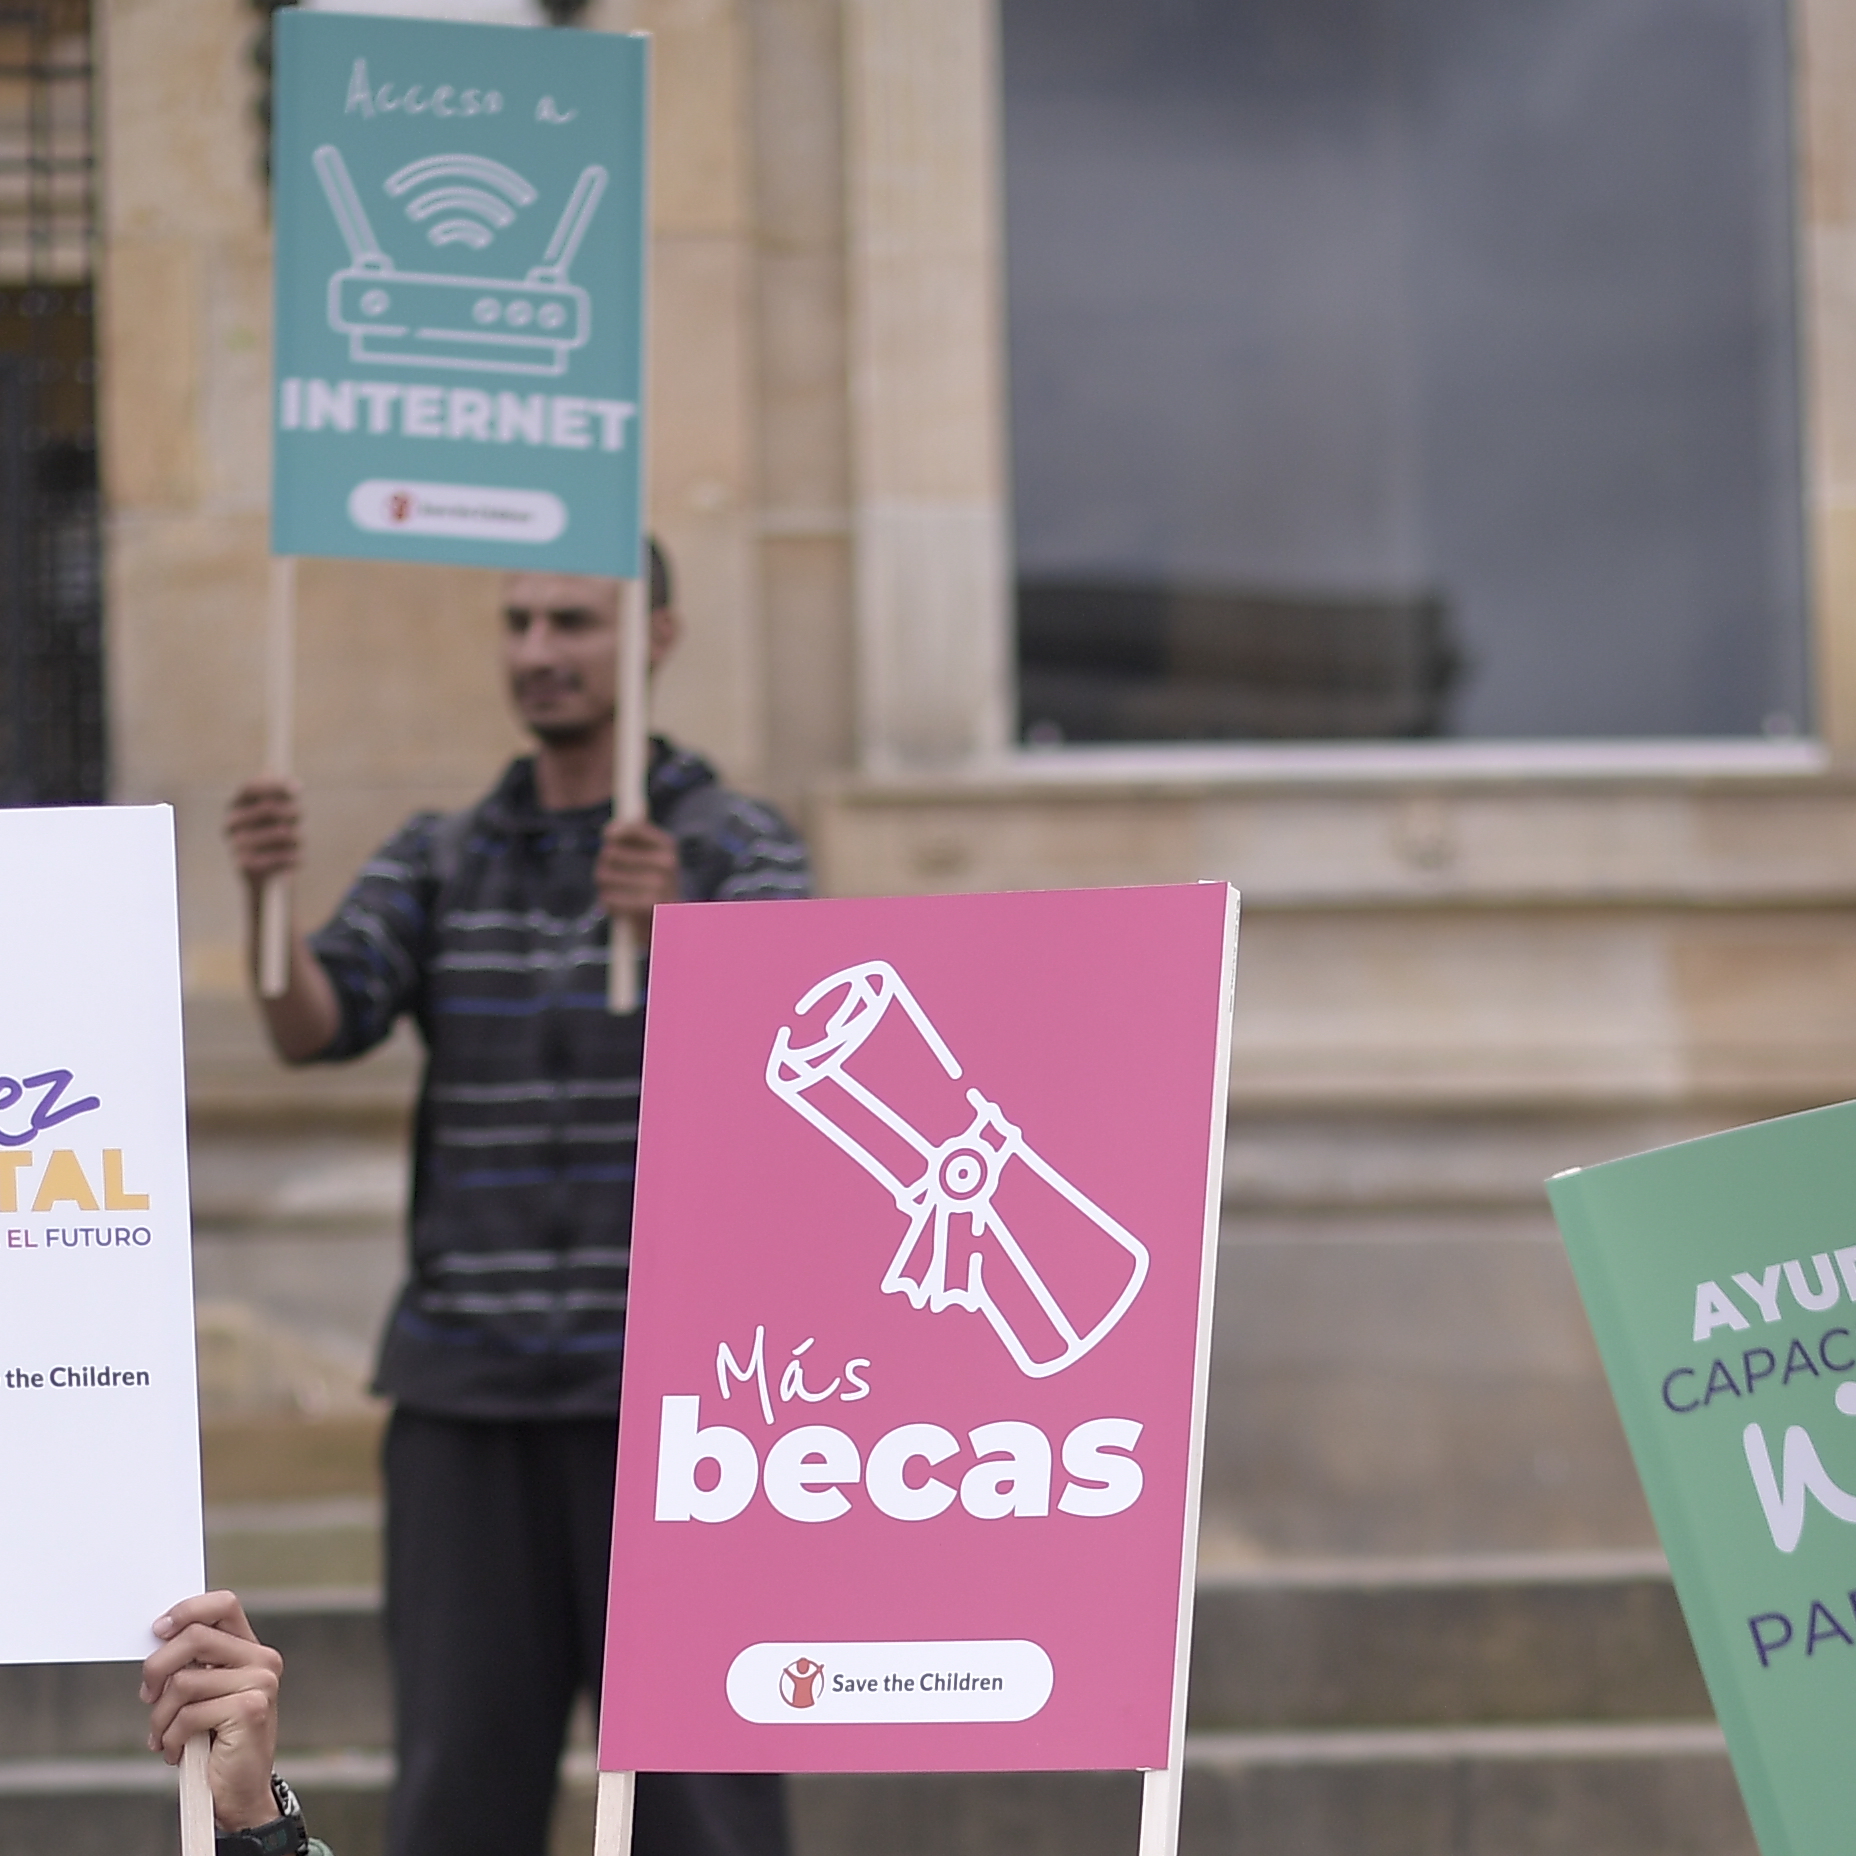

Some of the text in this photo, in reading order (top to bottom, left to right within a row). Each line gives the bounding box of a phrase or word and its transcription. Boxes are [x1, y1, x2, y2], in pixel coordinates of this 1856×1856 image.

[344, 57, 578, 123] Acceso a
[280, 377, 636, 452] INTERNET
[6, 1229, 38, 1249] EL
[45, 1227, 152, 1248] FUTURO
[5, 1368, 44, 1388] the
[49, 1366, 151, 1388] Children
[715, 1324, 872, 1425] Más
[654, 1393, 1145, 1524] becas
[831, 1672, 1004, 1694] Save the Children
